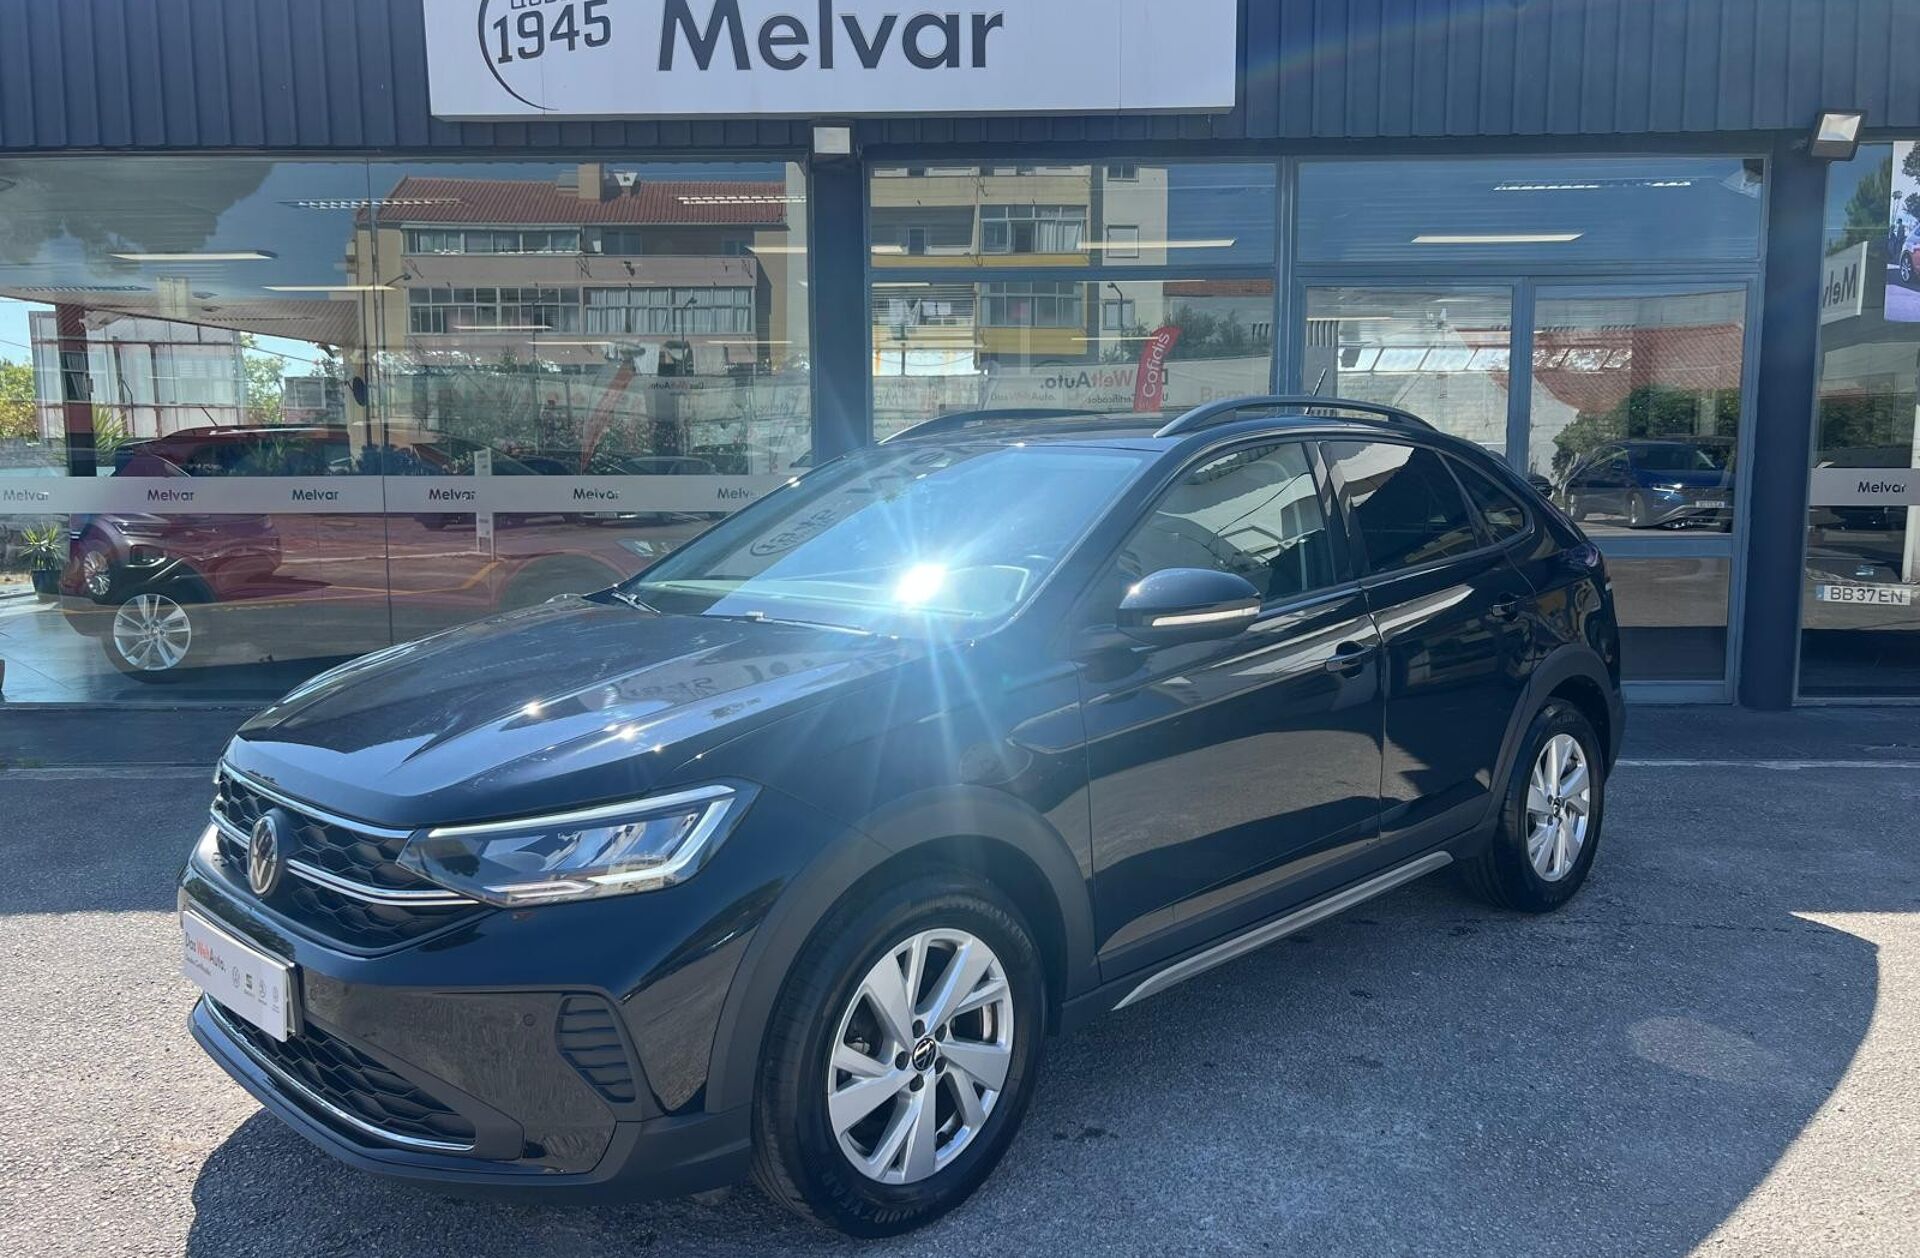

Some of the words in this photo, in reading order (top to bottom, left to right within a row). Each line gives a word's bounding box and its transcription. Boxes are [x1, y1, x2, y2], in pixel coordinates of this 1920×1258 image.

[493, 0, 611, 64] 1945
[657, 0, 1003, 71] Melvar
[1143, 332, 1170, 397] Cofidis
[573, 487, 619, 500] Melvar
[1857, 481, 1906, 494] Melvar
[3, 488, 49, 501] Melvar
[147, 488, 194, 501] Melvar
[292, 488, 339, 501] Melvar
[428, 488, 476, 501] Melvar
